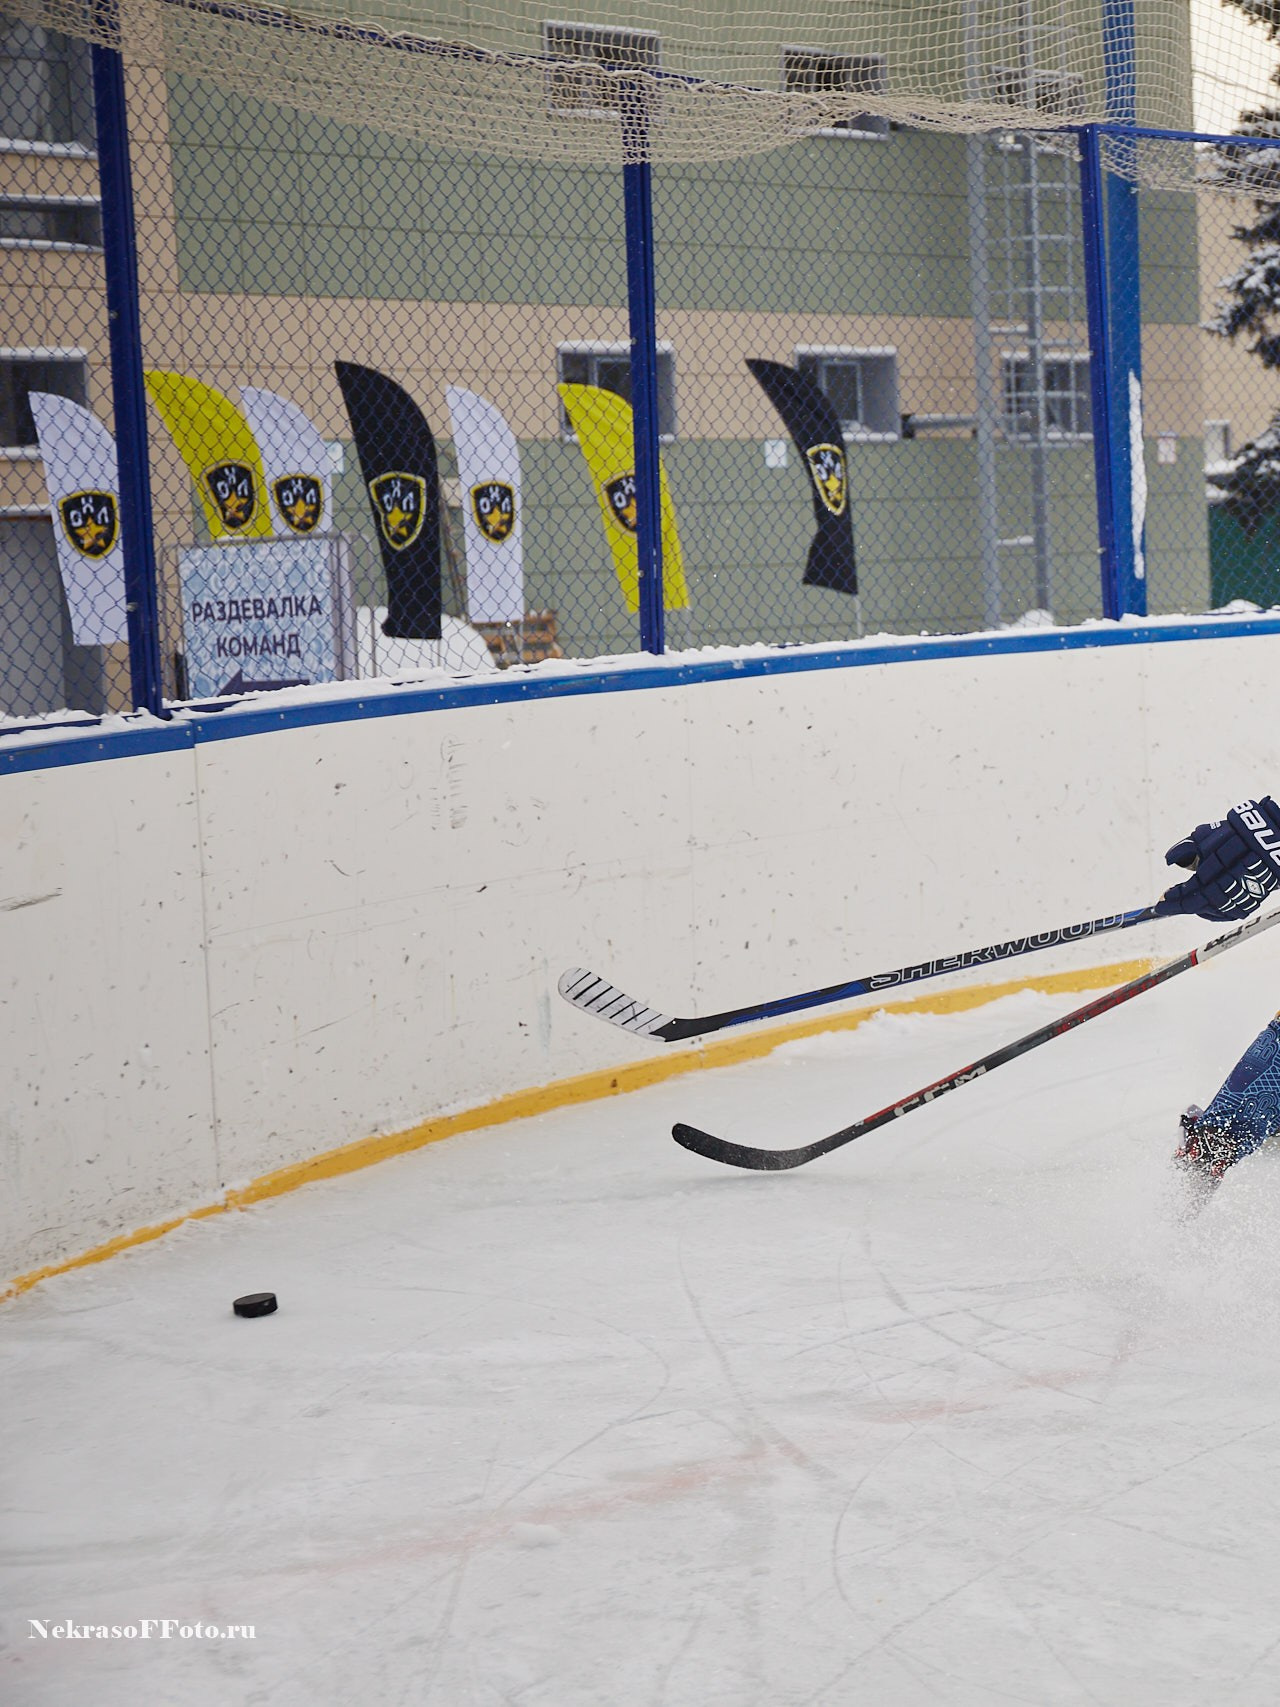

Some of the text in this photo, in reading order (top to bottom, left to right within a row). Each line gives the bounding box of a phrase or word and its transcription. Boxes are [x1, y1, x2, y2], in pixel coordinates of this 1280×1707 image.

[215, 466, 249, 499] ОХЛ
[281, 478, 317, 507] ОХЛ
[382, 479, 415, 512] ОХЛ
[613, 477, 637, 508] ОХ
[69, 496, 109, 528] ОХЛ
[479, 485, 511, 514] ОХЛ
[191, 594, 323, 625] РАЗДЕВАЛКА
[216, 633, 302, 659] КОМАНД
[870, 911, 1128, 991] SHERWOOD
